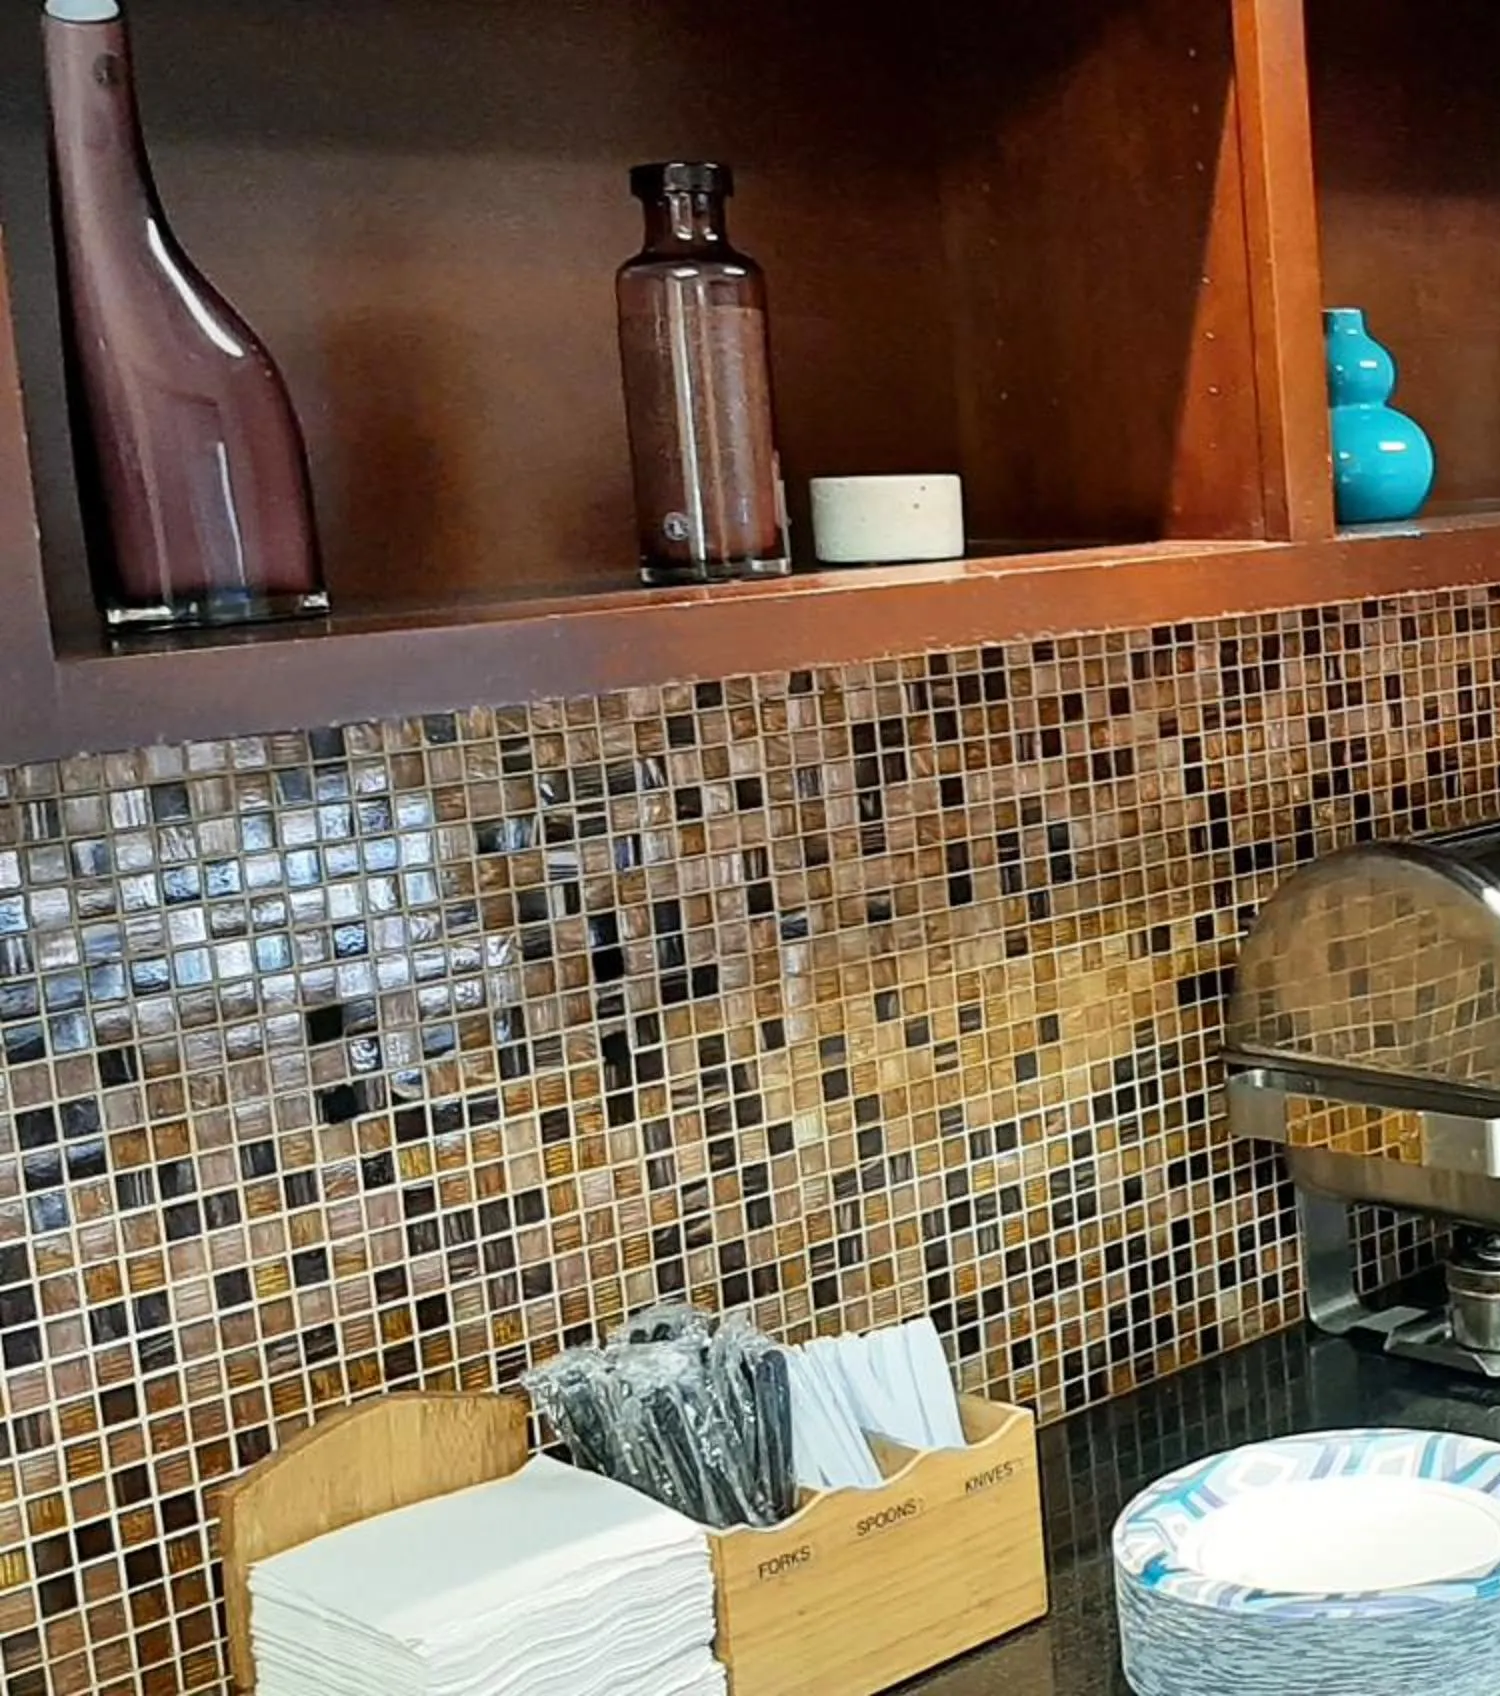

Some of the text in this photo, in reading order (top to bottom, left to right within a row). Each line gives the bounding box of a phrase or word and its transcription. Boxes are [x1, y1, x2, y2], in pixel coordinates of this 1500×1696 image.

[965, 1460, 1013, 1494] KNIVES
[856, 1497, 917, 1536] SPOONS
[758, 1545, 810, 1579] FORKS
